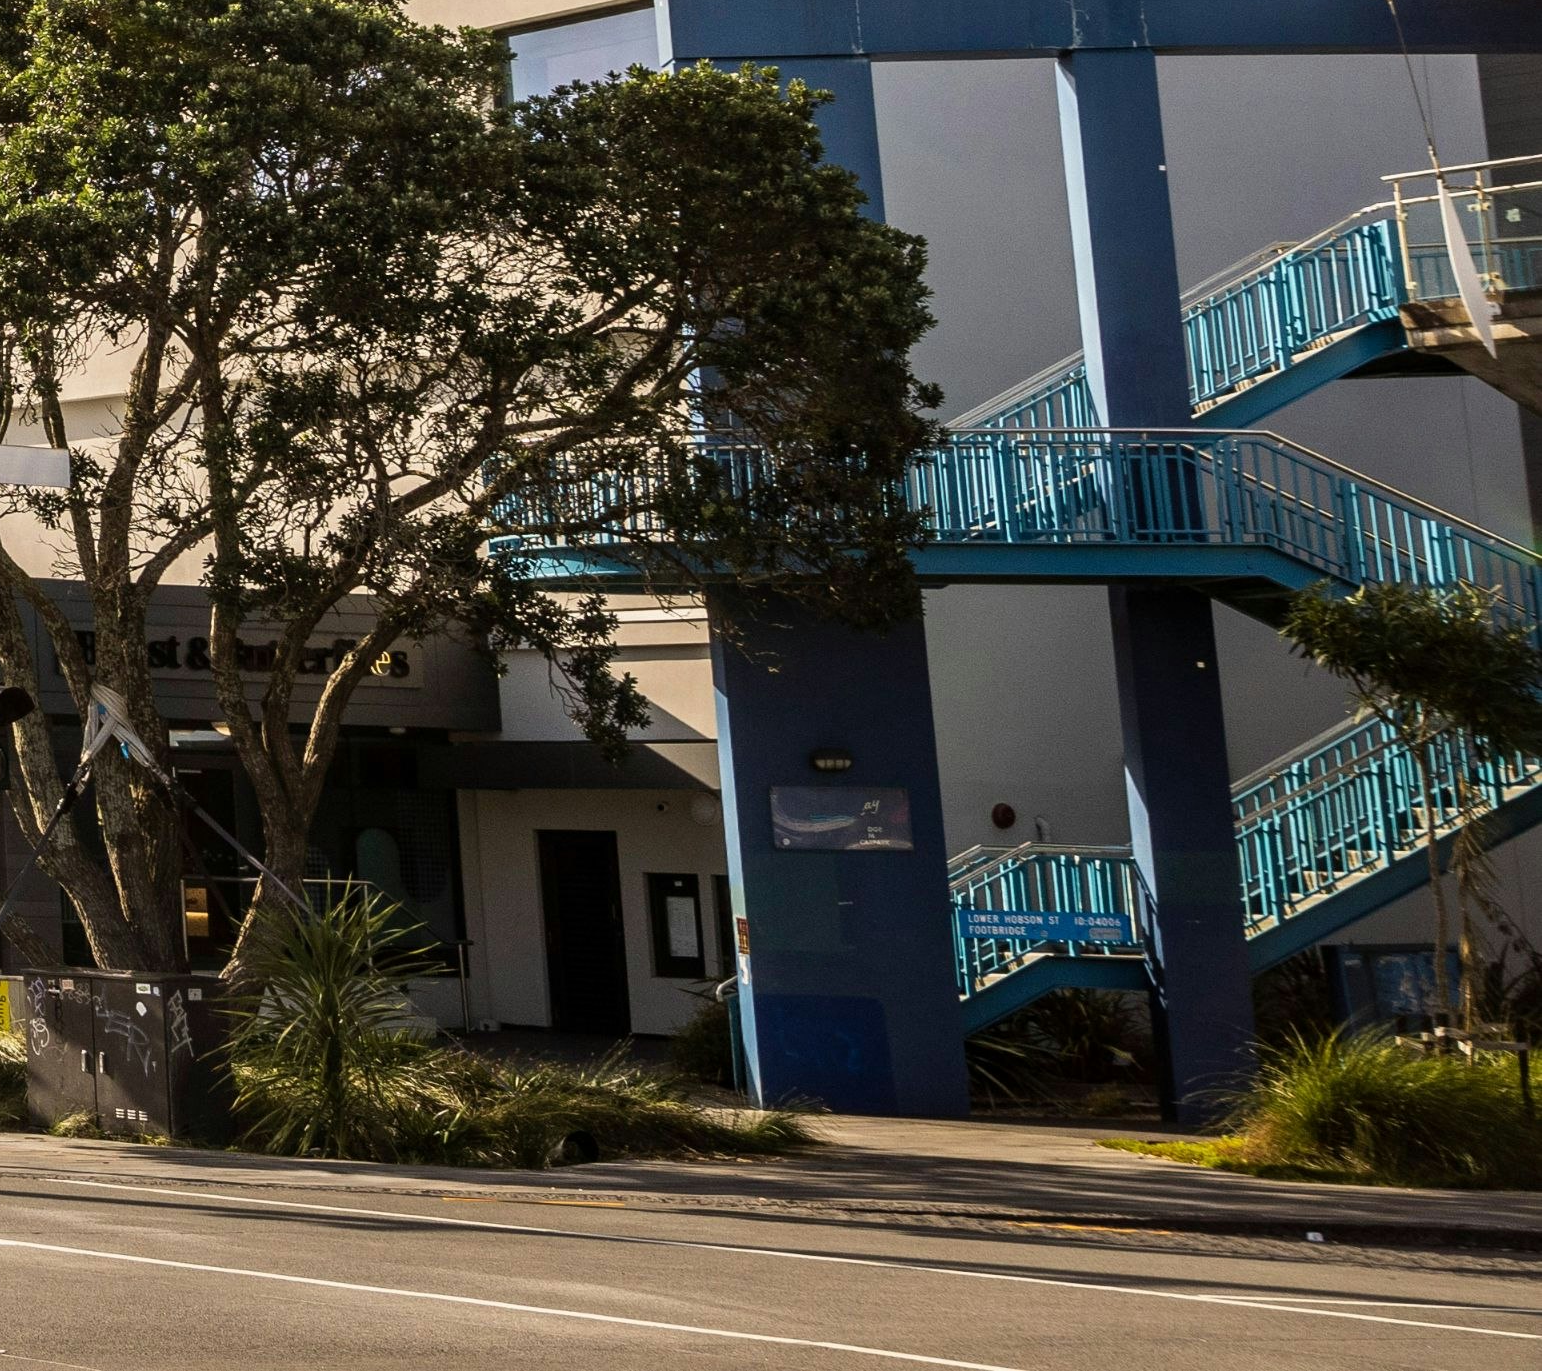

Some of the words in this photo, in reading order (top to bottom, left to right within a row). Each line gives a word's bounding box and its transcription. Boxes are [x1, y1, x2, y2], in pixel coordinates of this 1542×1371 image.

[968, 914, 999, 923] LOWER
[1004, 915, 1043, 925] HOBSON
[1048, 916, 1060, 925] ST
[969, 926, 1027, 936] FOOTBRIDGE
